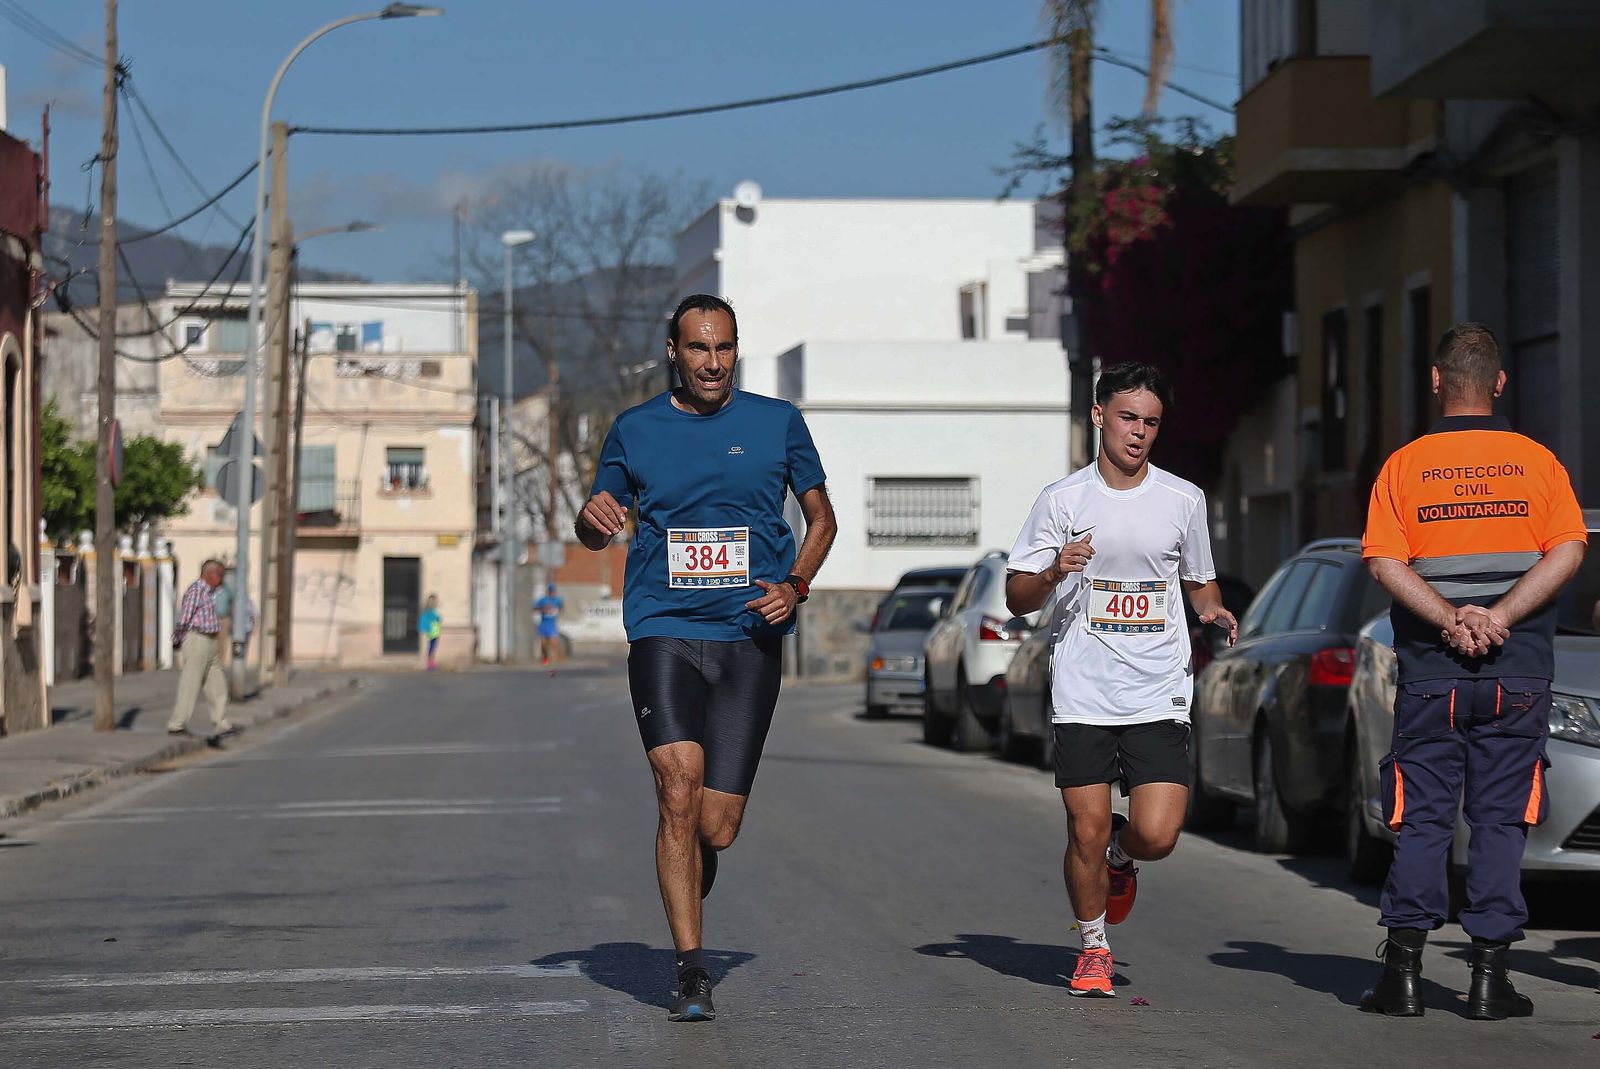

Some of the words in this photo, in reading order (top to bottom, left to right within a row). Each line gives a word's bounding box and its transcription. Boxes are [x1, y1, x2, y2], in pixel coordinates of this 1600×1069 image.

[1421, 462, 1524, 482] PROTECCIÓN
[1453, 483, 1494, 497] CIVIL
[1420, 503, 1527, 520] VOLUNTARIADO
[697, 532, 718, 542] CROSS
[685, 544, 729, 570] 384
[1121, 582, 1140, 592] CROSS
[1106, 594, 1149, 618] 409
